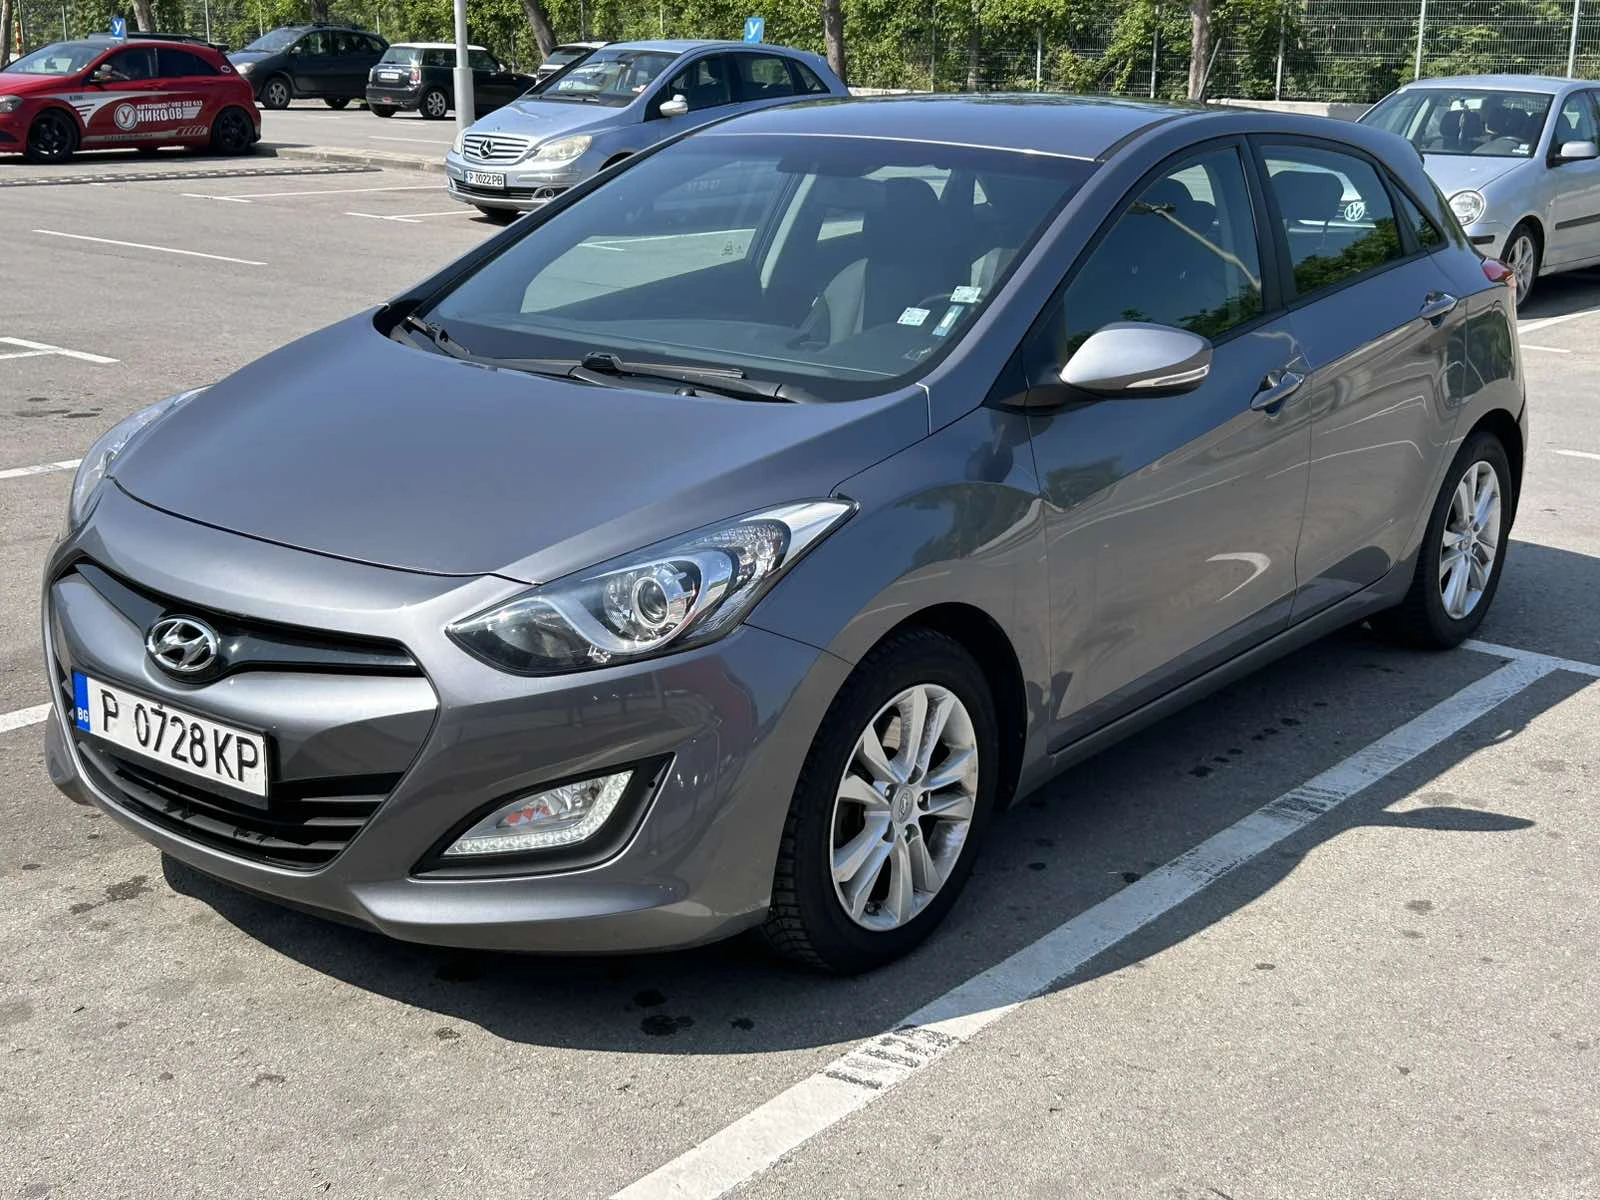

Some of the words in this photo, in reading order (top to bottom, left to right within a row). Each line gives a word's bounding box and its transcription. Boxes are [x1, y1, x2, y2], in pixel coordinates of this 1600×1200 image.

[114, 20, 122, 35] У
[747, 21, 760, 39] У
[468, 172, 474, 181] P
[76, 707, 90, 722] BG
[101, 689, 120, 732] P
